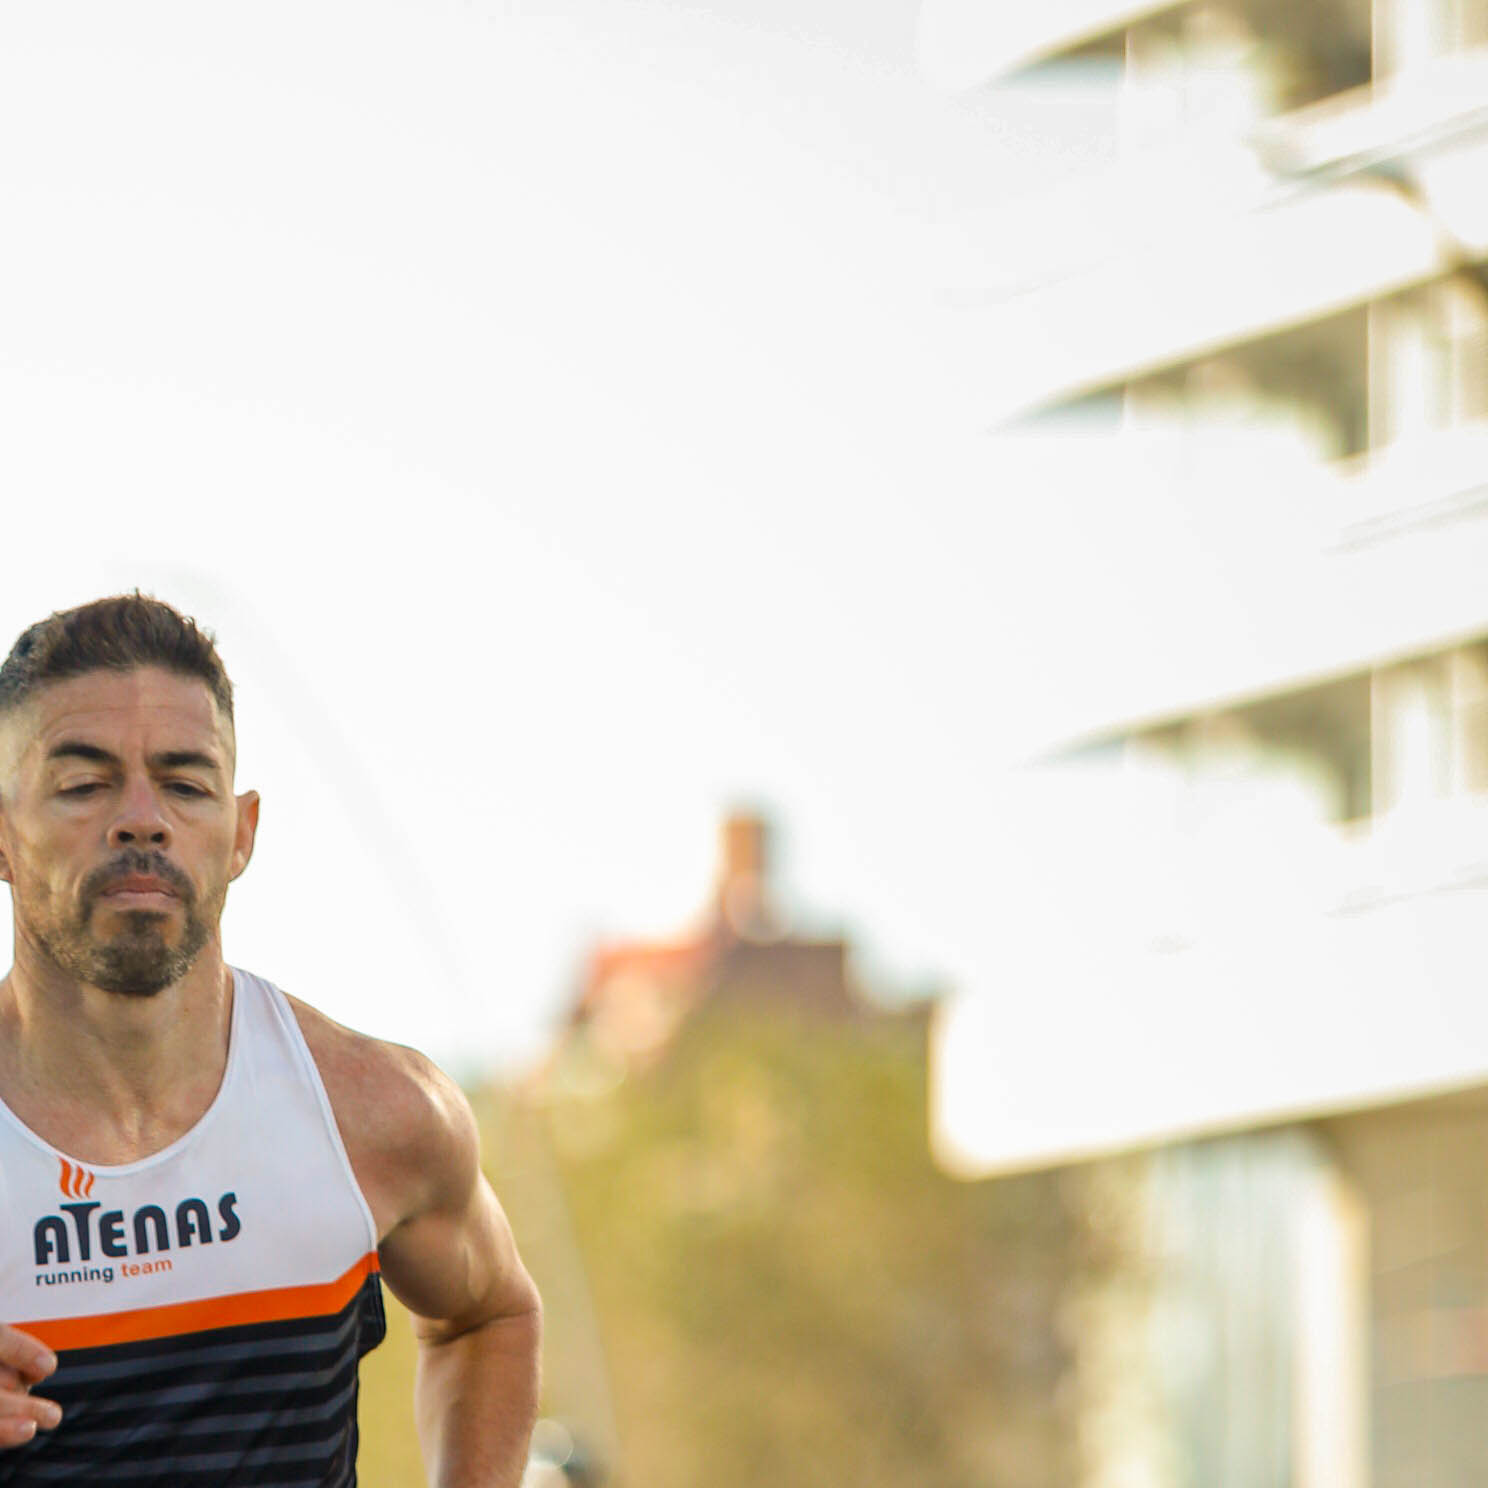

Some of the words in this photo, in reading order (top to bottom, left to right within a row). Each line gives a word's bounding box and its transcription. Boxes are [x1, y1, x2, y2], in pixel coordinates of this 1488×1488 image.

[34, 1192, 242, 1265] ATENAS
[36, 1266, 114, 1286] running
[121, 1256, 173, 1278] team
